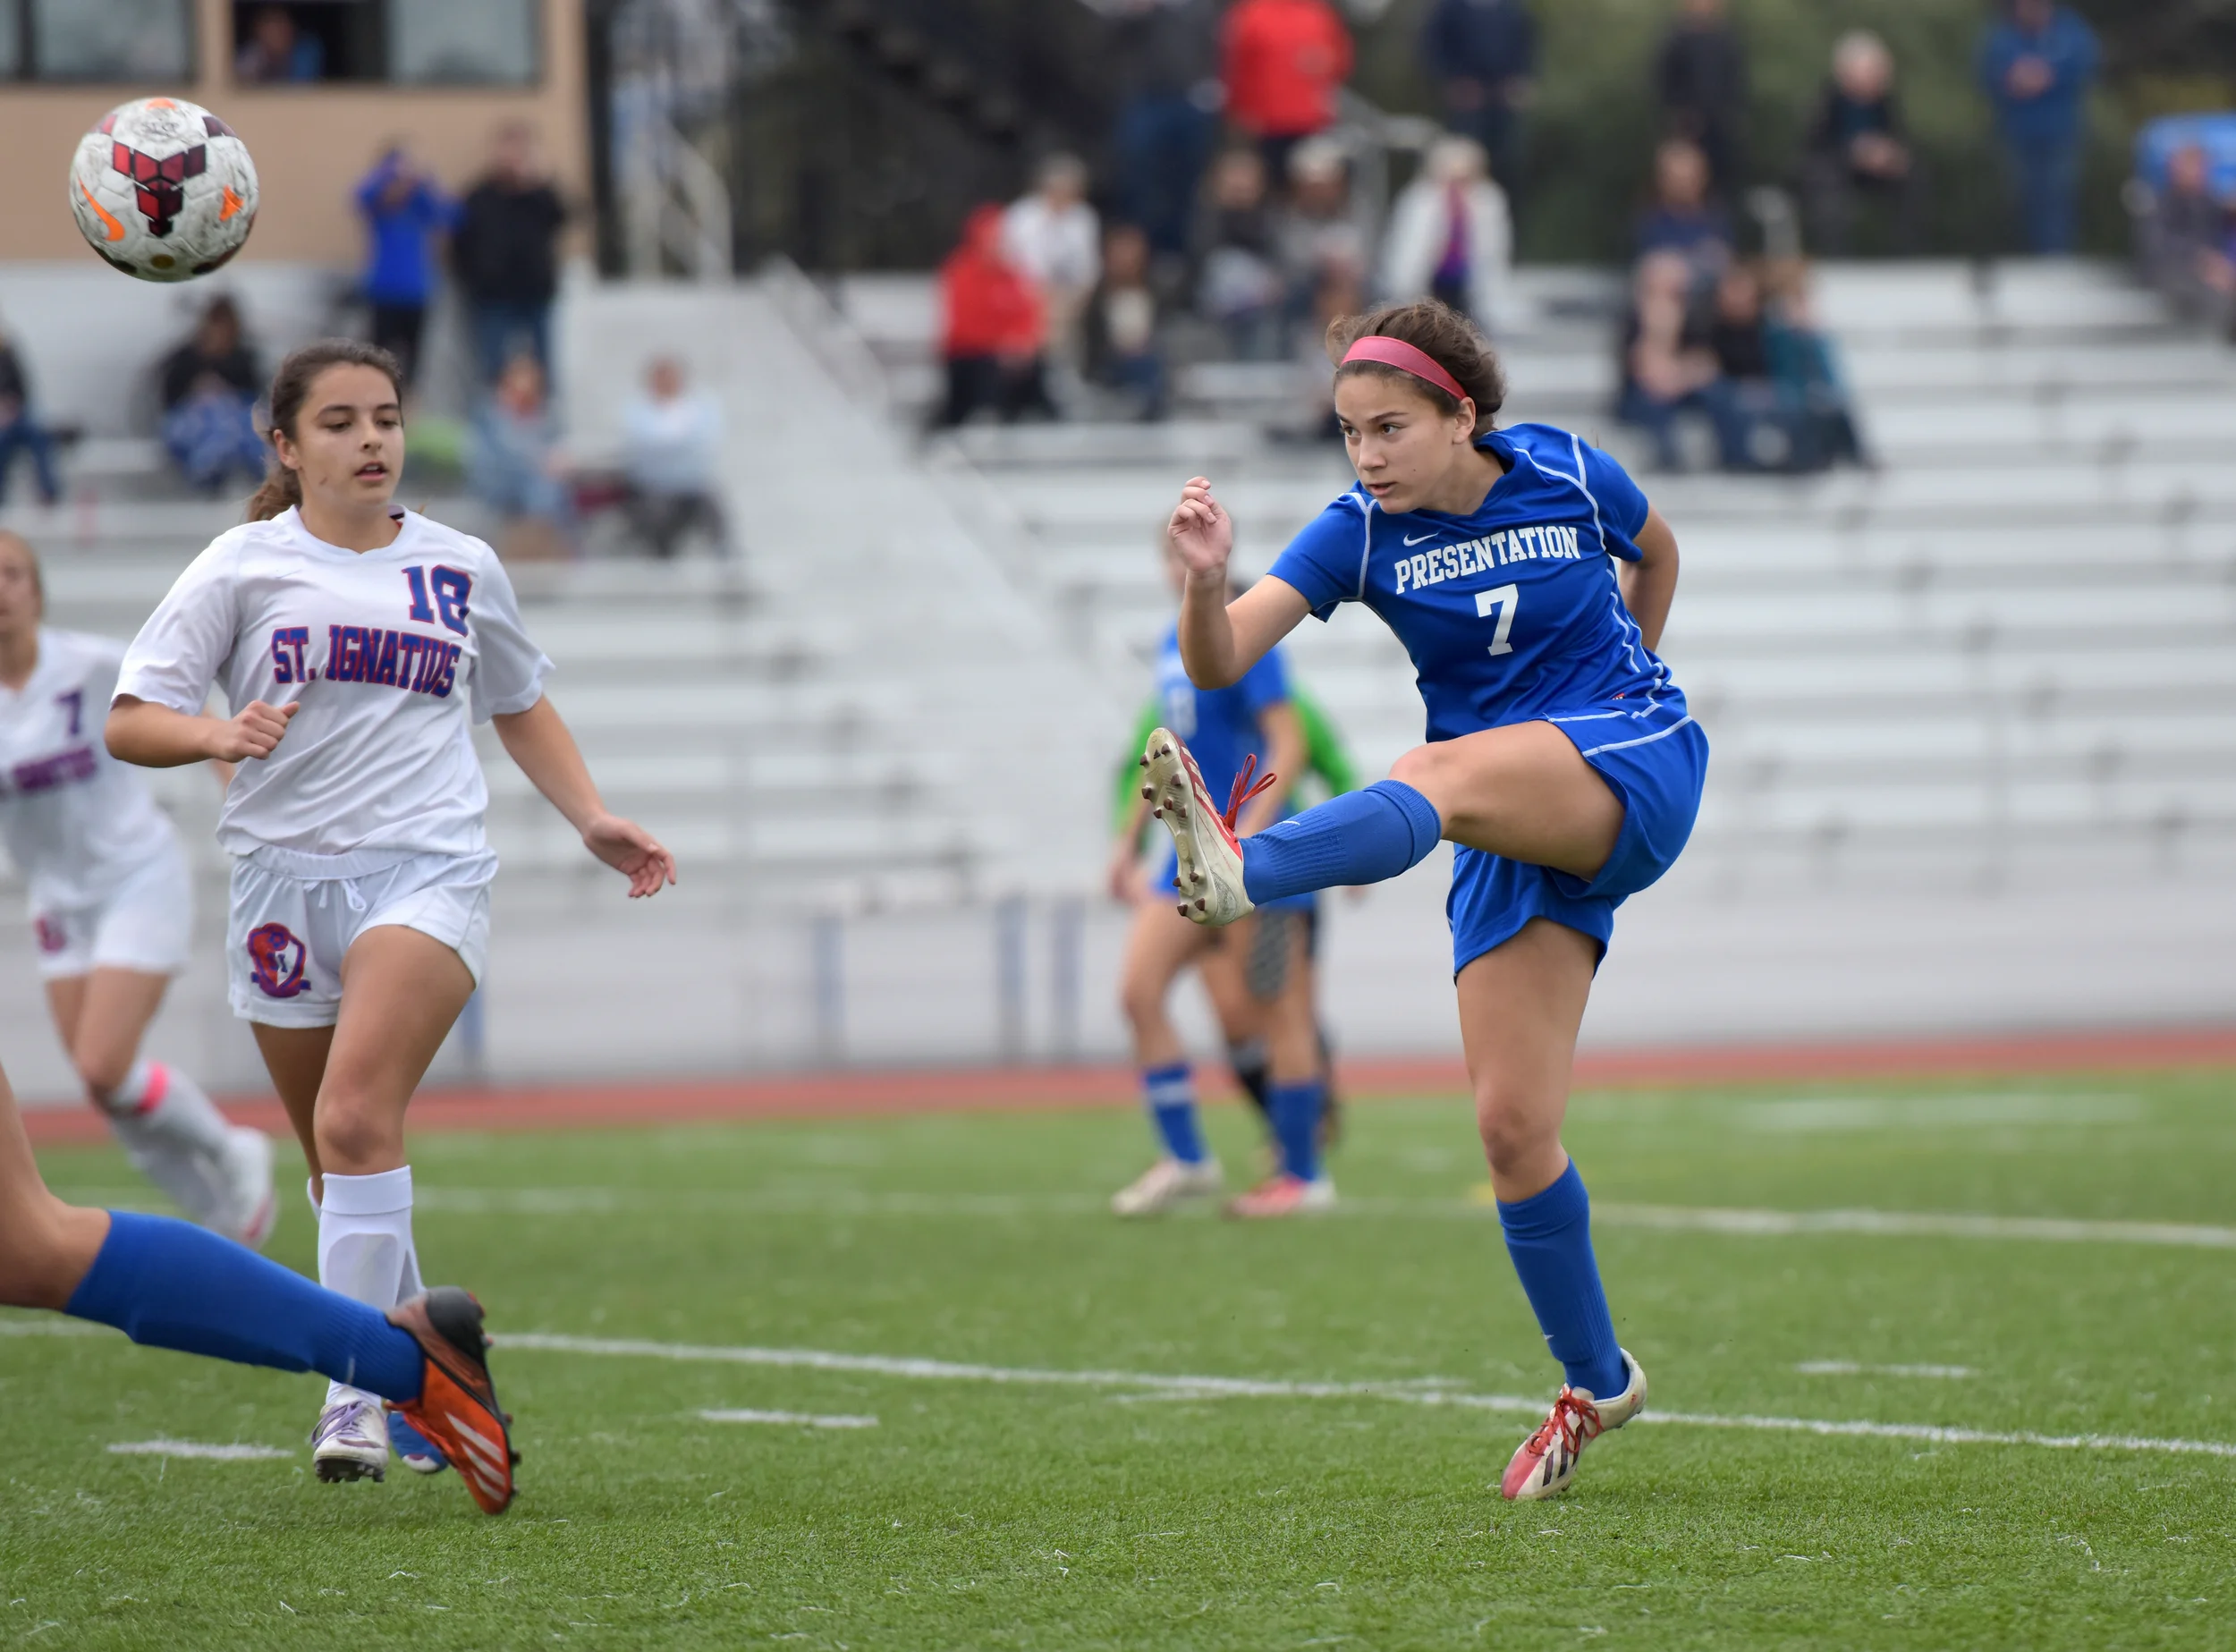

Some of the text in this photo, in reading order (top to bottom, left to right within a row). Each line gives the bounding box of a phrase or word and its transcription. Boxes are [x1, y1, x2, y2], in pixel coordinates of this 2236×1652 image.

[1394, 526, 1580, 595] PRESENTATION
[401, 564, 473, 638] 18
[1475, 583, 1519, 657] 7
[271, 624, 462, 698] ST. IGNATIUS
